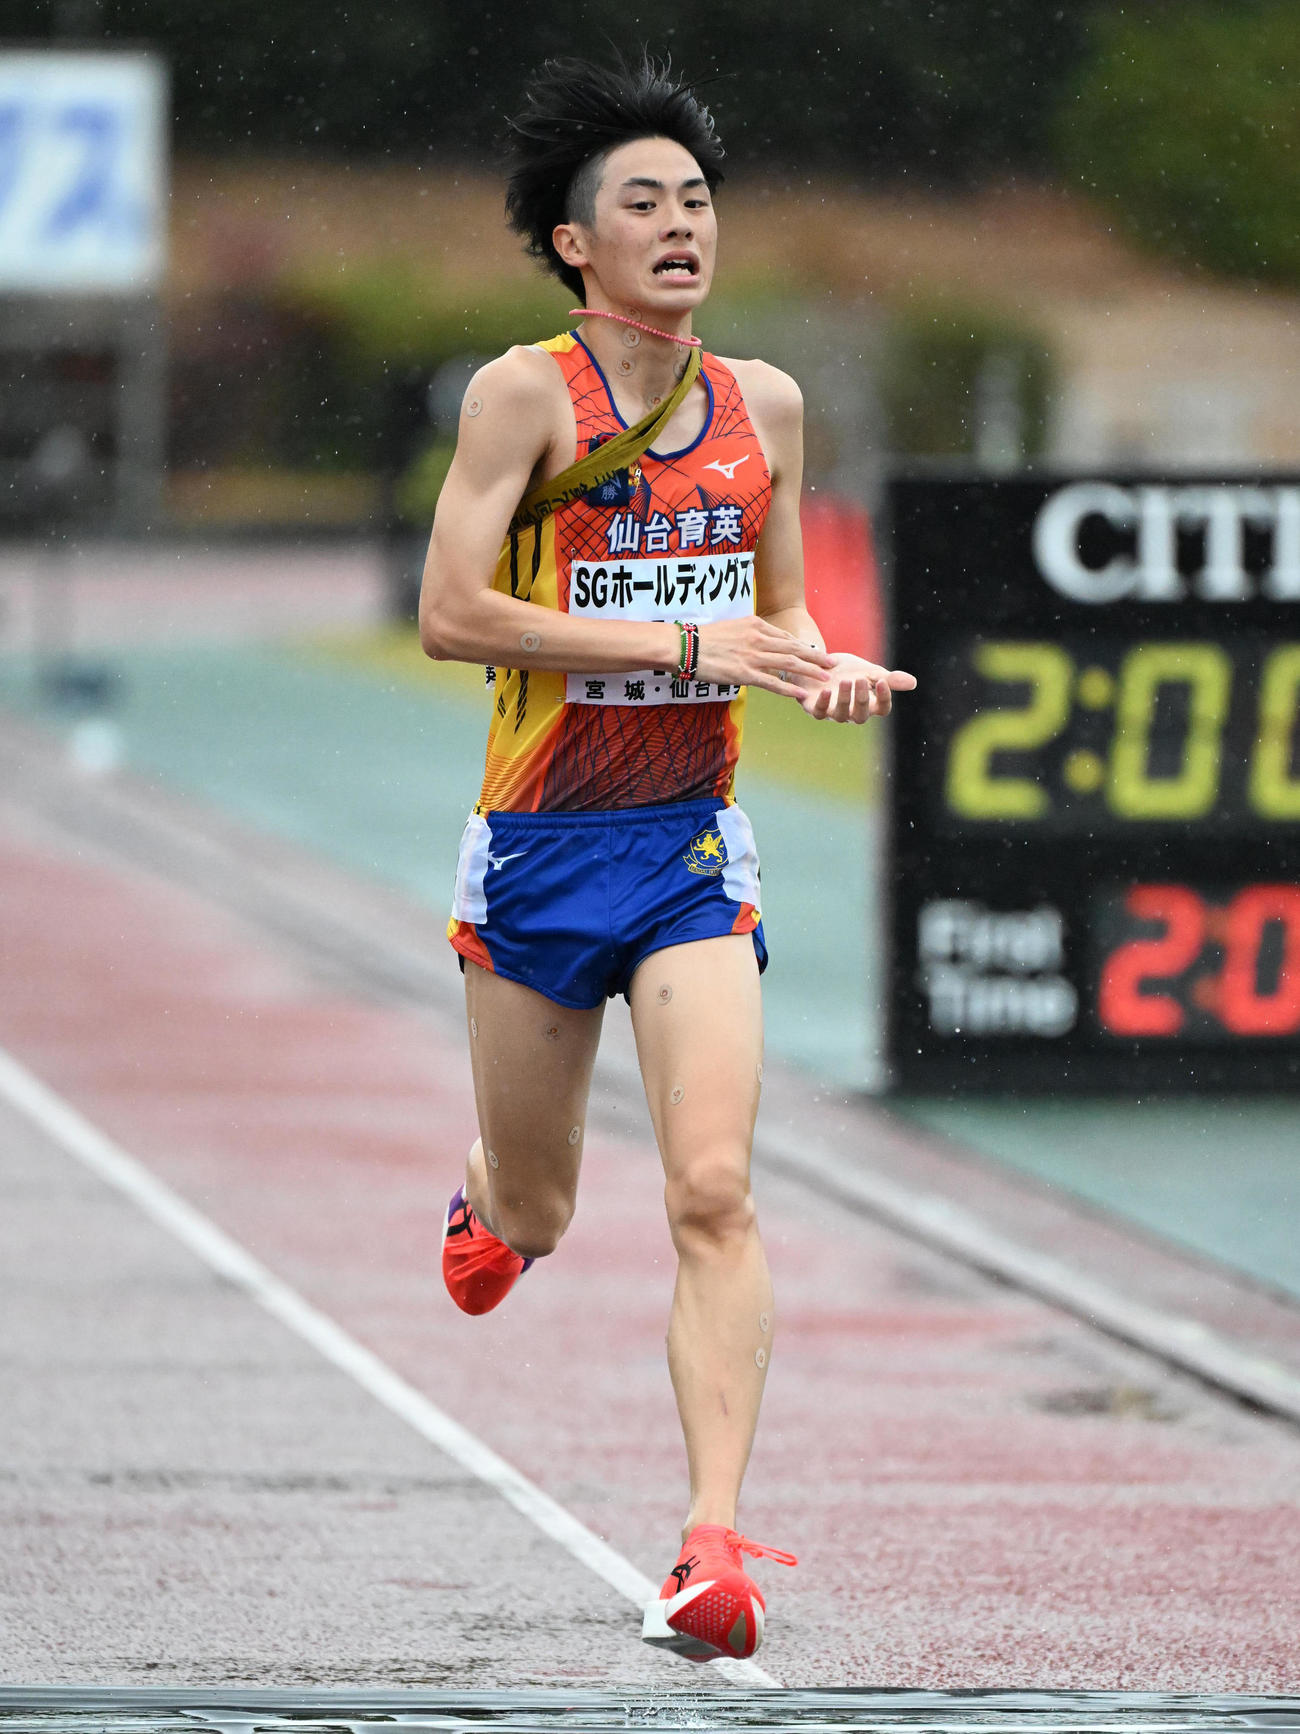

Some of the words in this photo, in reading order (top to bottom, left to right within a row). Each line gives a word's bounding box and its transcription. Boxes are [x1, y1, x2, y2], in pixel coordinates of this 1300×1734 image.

[606, 506, 742, 553] 仙台育英
[574, 557, 751, 608] SGホールディングス
[585, 679, 741, 701] 宮城・仙台育
